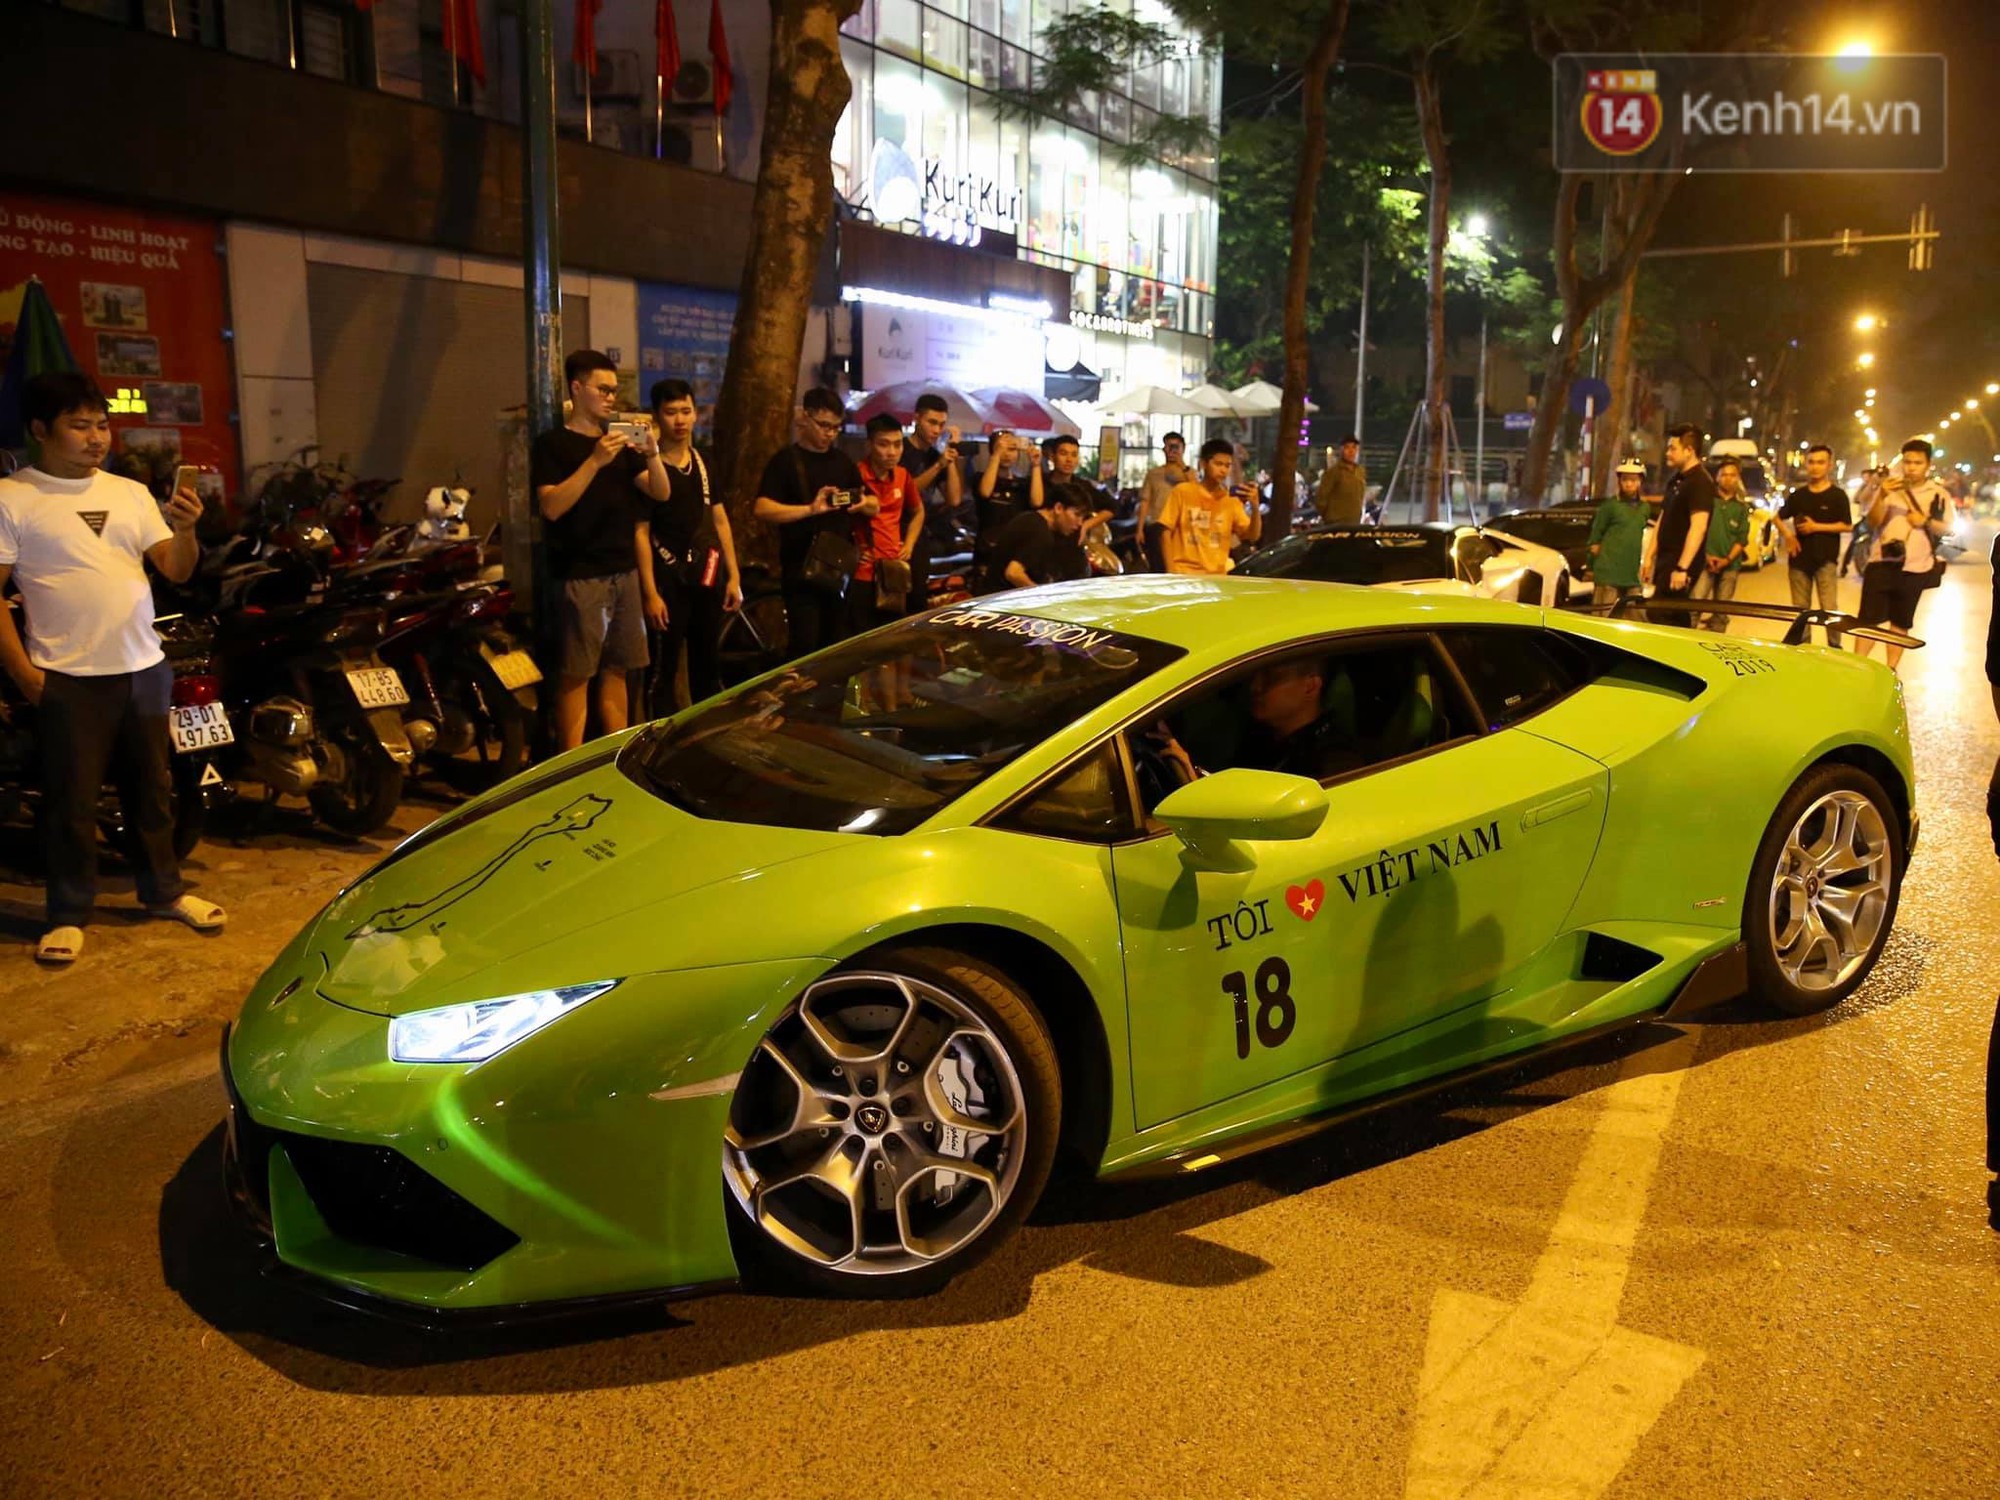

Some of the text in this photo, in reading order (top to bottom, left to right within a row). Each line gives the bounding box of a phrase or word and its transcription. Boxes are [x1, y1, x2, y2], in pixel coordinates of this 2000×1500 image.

[16, 213, 74, 235] ĐỘNG
[91, 225, 136, 244] LINH
[929, 610, 1112, 649] CAR PASSION
[1725, 659, 1776, 676] 2019
[1207, 821, 1504, 951] TÔI VIỆT NAM
[1221, 956, 1297, 1060] 18
